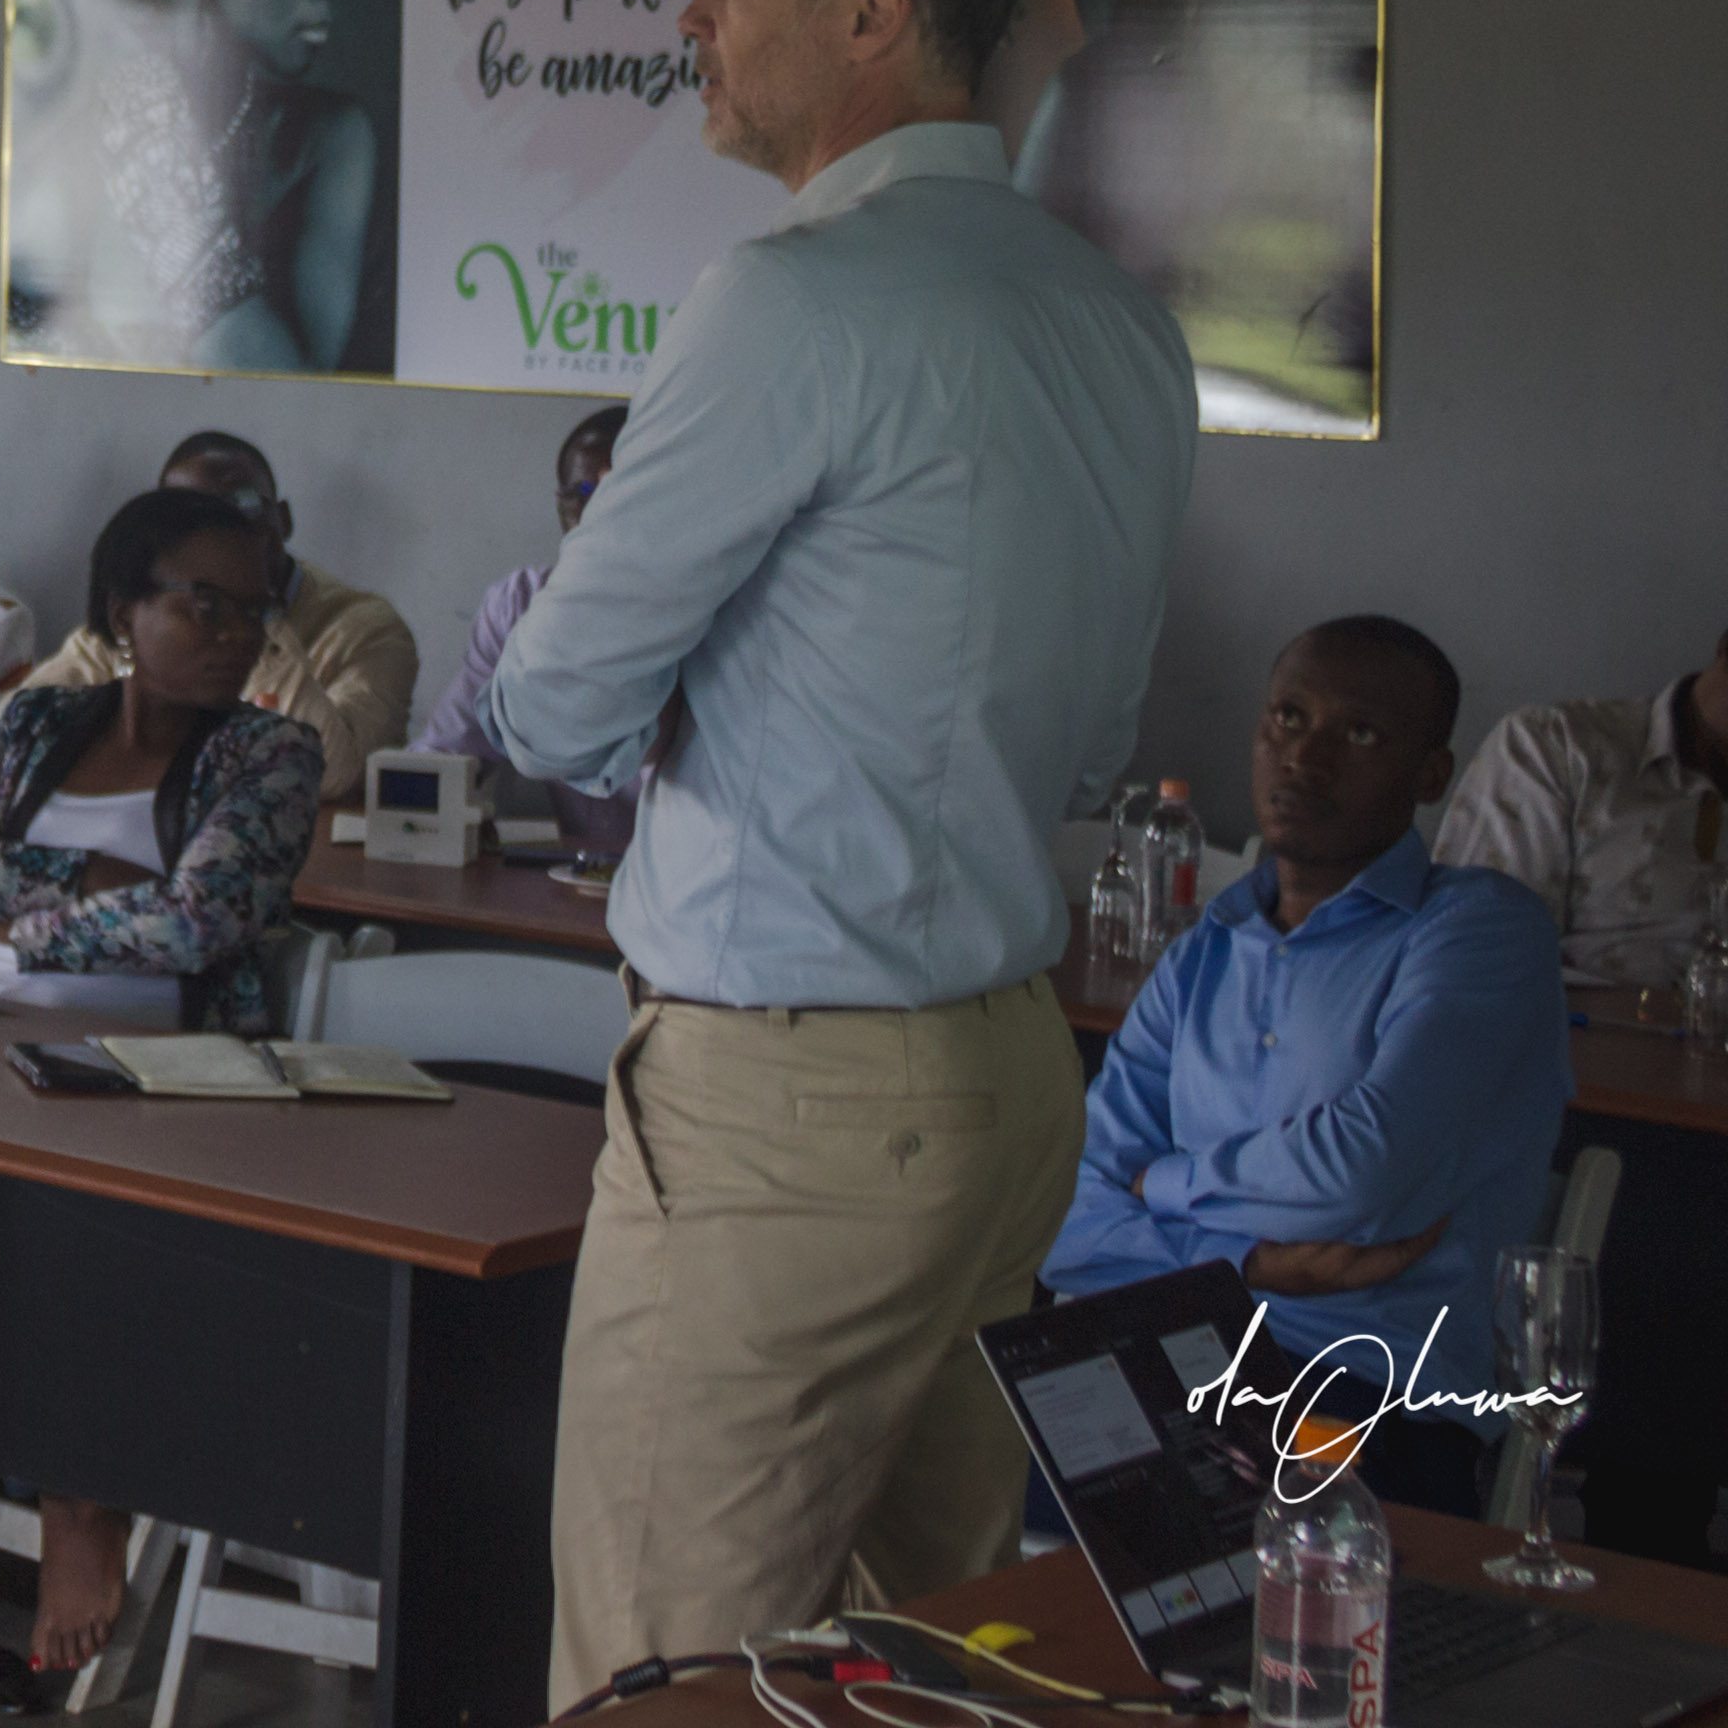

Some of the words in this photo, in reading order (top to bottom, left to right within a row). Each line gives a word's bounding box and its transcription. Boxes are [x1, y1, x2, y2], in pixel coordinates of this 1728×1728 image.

[476, 16, 532, 99] be
[536, 240, 577, 268] the
[557, 356, 609, 373] FACE
